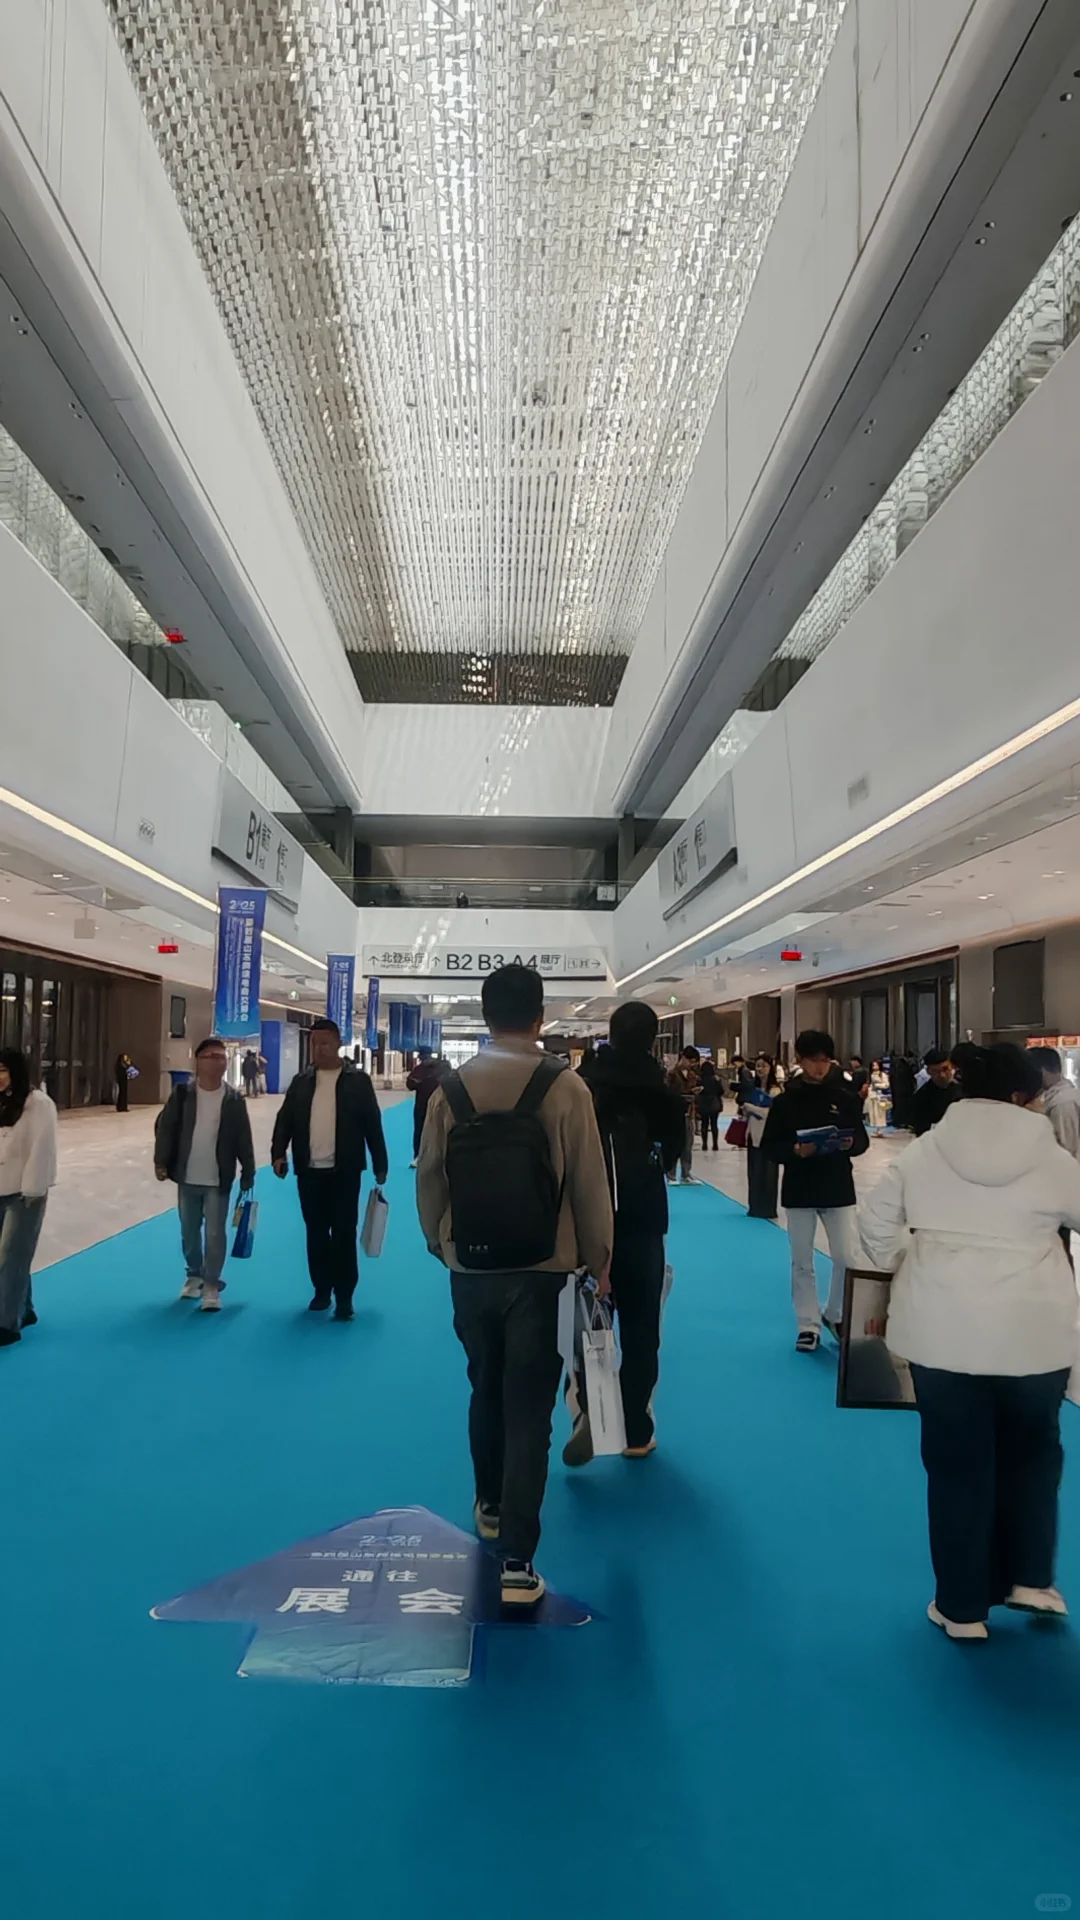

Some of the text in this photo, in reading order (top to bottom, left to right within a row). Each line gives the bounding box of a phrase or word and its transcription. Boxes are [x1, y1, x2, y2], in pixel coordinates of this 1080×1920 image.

[446, 954, 538, 971] B2 B3 A4
[341, 1570, 418, 1582] 通往
[275, 1587, 465, 1615] 展会
